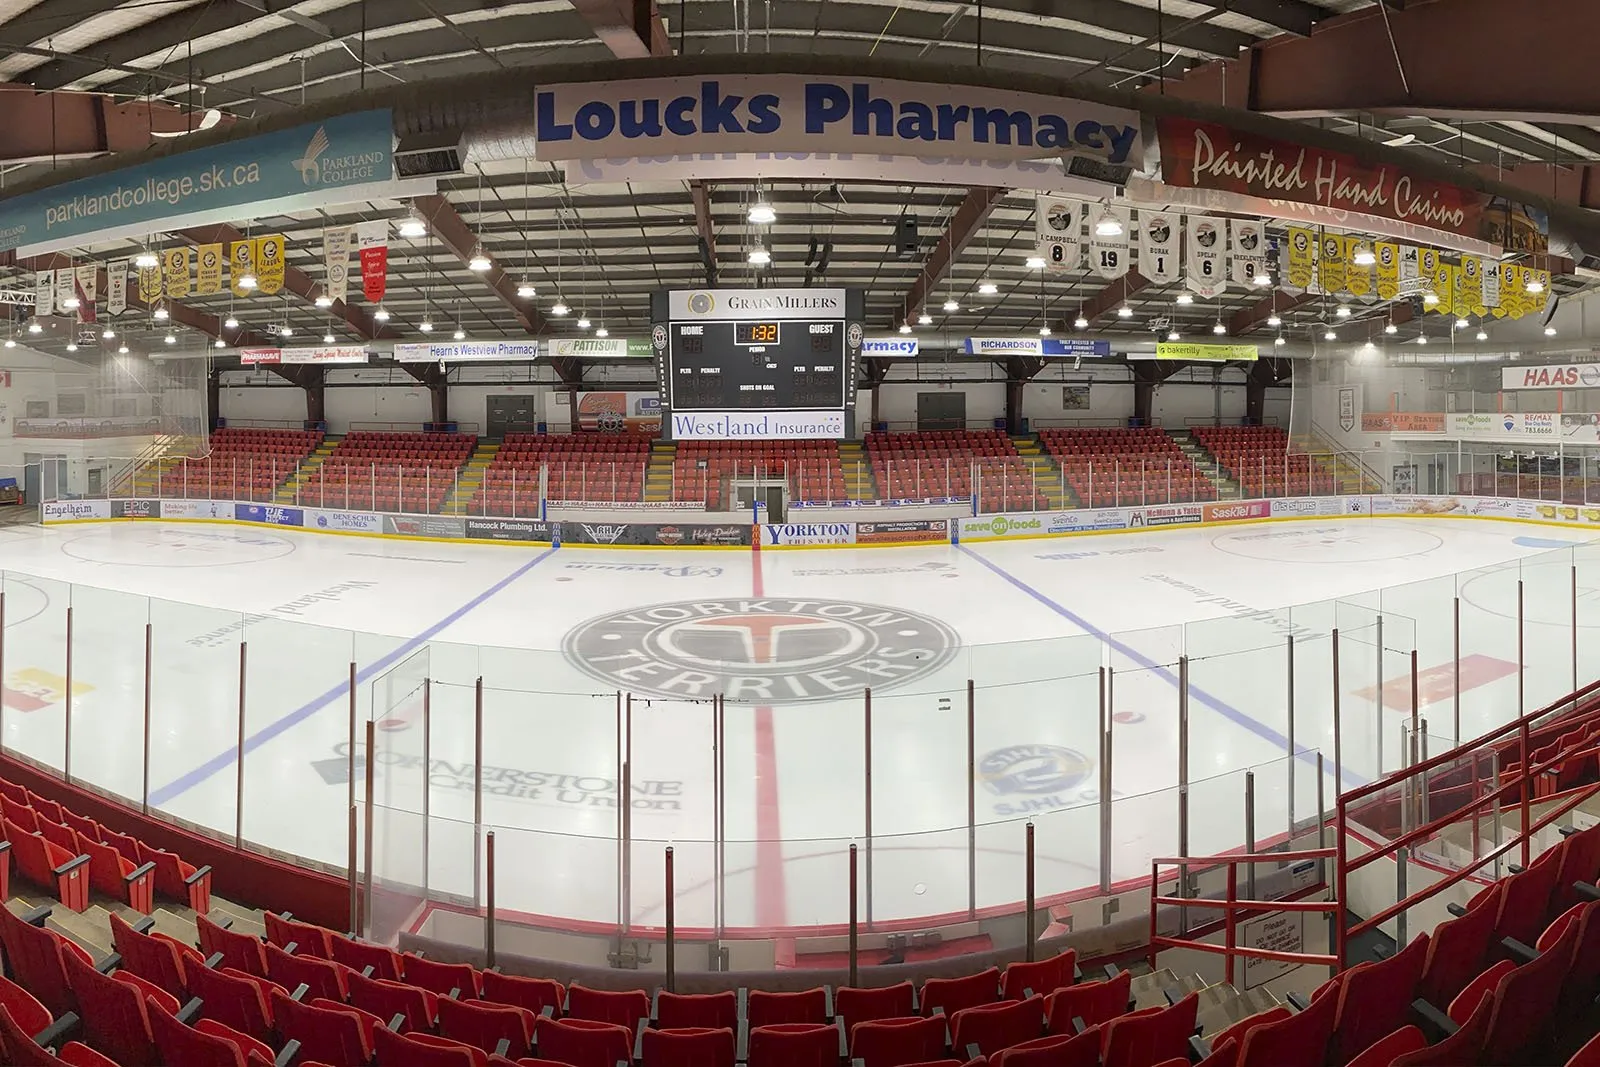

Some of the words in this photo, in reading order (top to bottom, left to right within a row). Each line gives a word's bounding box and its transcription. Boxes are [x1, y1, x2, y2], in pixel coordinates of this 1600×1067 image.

[537, 81, 781, 142] Loucks
[805, 83, 1139, 165] Pharmacy
[322, 151, 384, 171] PARKLAND
[322, 166, 374, 185] COLLEGE
[1192, 128, 1308, 191] Painted
[1314, 156, 1387, 208] Hand
[1393, 176, 1464, 229] Casino
[46, 161, 260, 231] parklandcollege.sk.ca
[1046, 235, 1078, 245] CAMPBELL
[1052, 245, 1063, 262] 8
[1101, 251, 1118, 268] 19
[1157, 257, 1165, 273] 1
[1203, 260, 1212, 276] 6
[1245, 263, 1255, 278] 9
[728, 295, 772, 310] GRAIN
[777, 295, 838, 309] MILLERS
[681, 326, 704, 336] HOME
[752, 325, 776, 340] 1:32
[809, 324, 834, 334] GUEST
[430, 345, 459, 357] Hearn's
[461, 344, 497, 356] Westview
[499, 343, 537, 357] Pharmacy
[574, 341, 618, 351] PATTISON
[981, 340, 1037, 350] RICHARDSON
[1524, 367, 1578, 387] HAAS
[674, 415, 768, 438] Westland
[775, 423, 841, 435] Insurance
[124, 501, 150, 510] EPIC
[1211, 506, 1249, 518] SaskTel
[1289, 501, 1316, 511] signs
[342, 520, 368, 528] HOMES
[469, 521, 499, 530] Hancock
[500, 522, 533, 532] Plumbing
[964, 523, 990, 531] save
[1009, 518, 1042, 530] foods
[767, 524, 850, 545] YORKTON
[608, 599, 900, 628] YORKTON
[588, 646, 936, 696] TERRIERS
[429, 773, 540, 800] Credit
[558, 789, 682, 811] Unon
